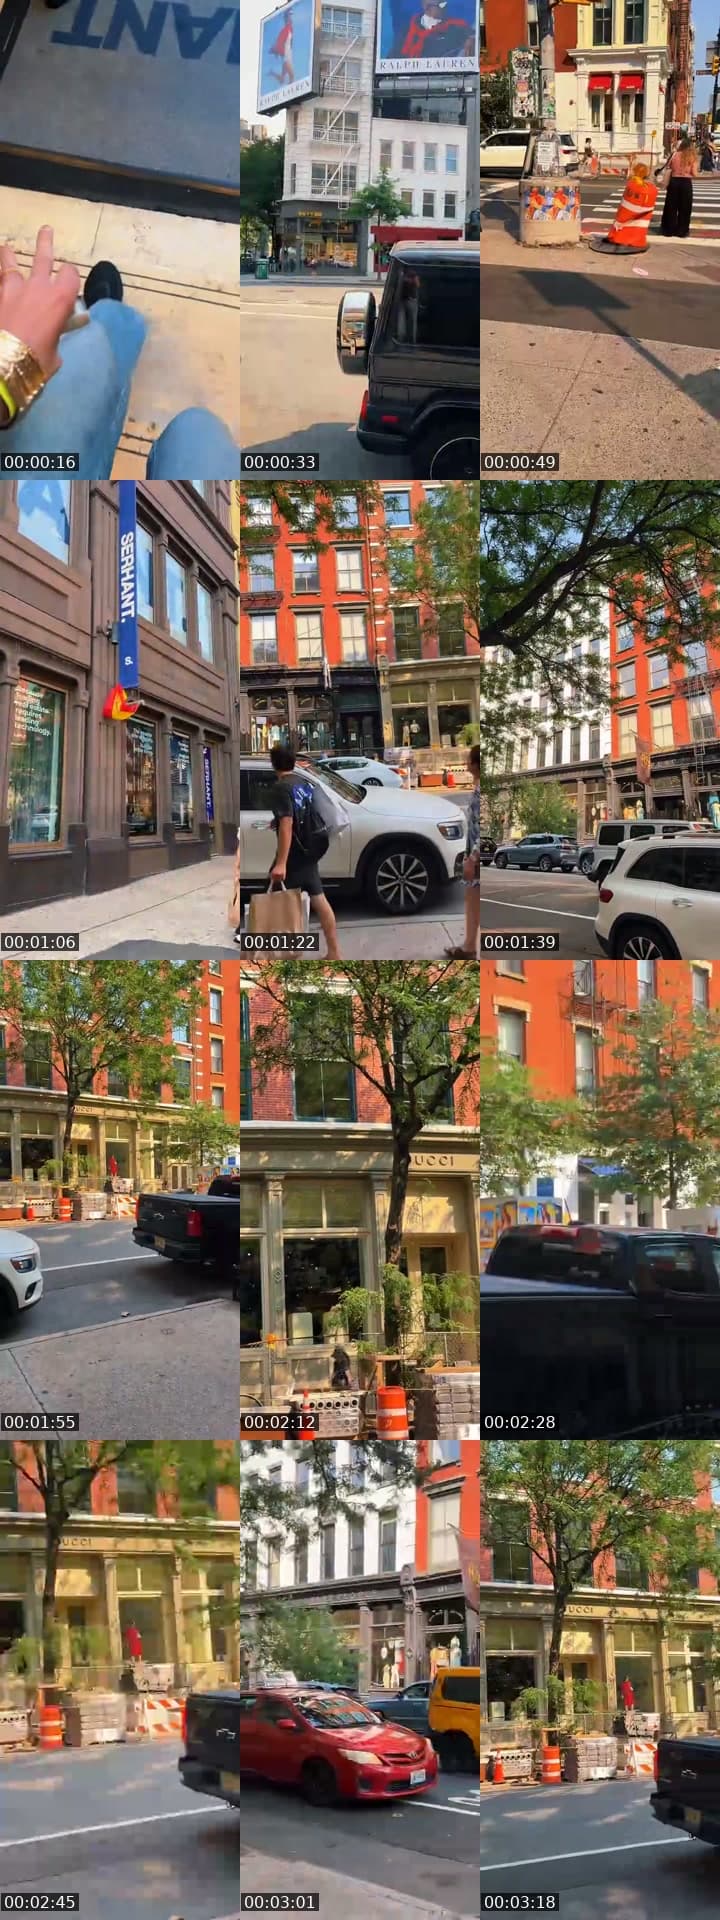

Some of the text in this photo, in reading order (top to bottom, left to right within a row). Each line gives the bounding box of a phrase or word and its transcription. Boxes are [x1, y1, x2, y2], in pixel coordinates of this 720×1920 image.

[380, 59, 474, 70] RALPH LAUREN
[121, 531, 135, 623] SERHANT.
[408, 1155, 454, 1167] UCCI
[57, 1537, 92, 1546] UCCI
[563, 1605, 593, 1614] UCCI
